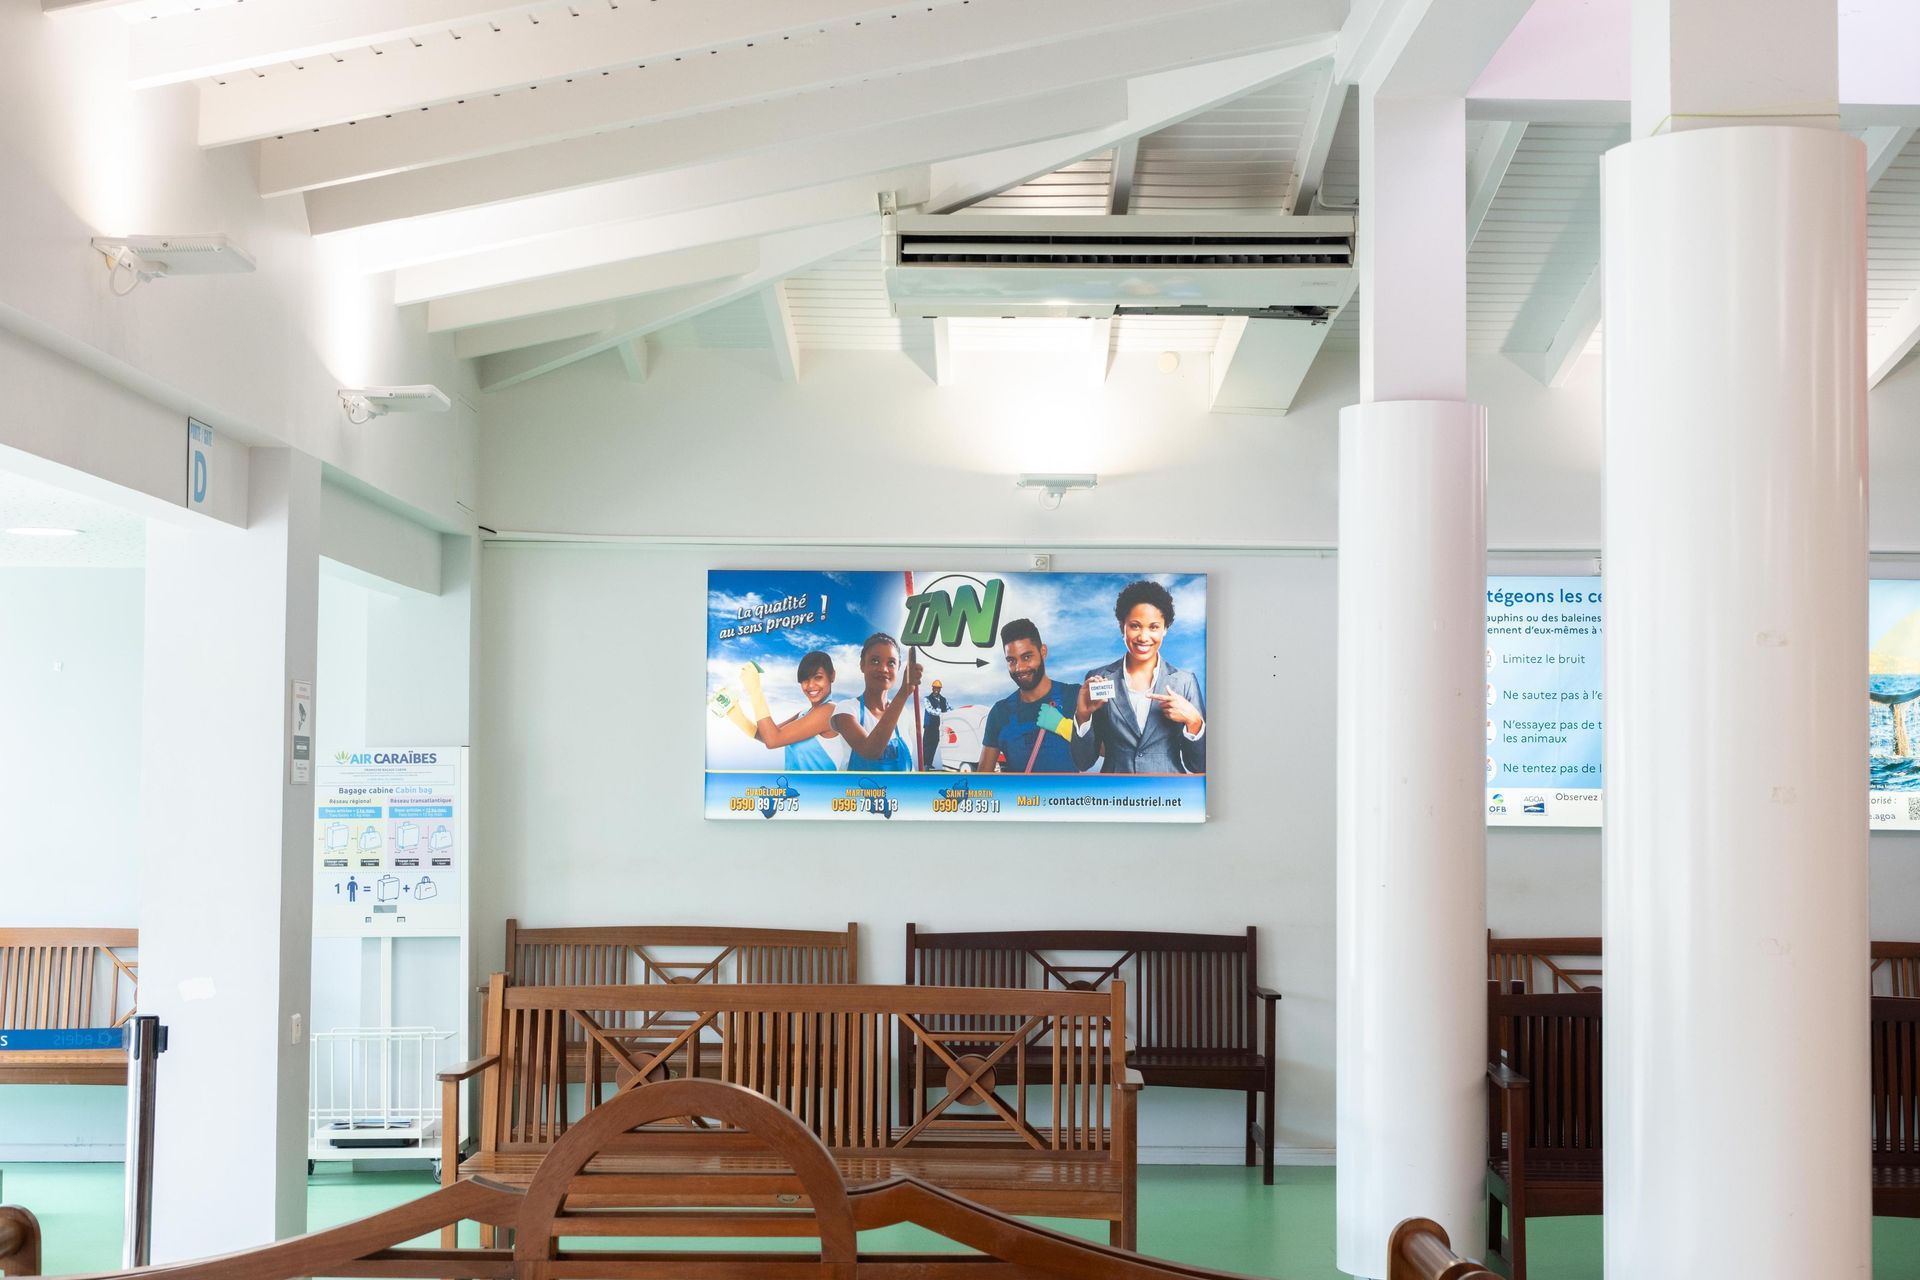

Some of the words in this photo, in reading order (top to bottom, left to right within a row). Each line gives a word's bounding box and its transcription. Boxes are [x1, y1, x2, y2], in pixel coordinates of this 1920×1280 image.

[194, 450, 207, 503] D
[1487, 588, 1554, 607] tégeons
[1560, 588, 1583, 603] les
[737, 607, 752, 620] La
[755, 594, 807, 619] qualité
[900, 578, 1004, 648] TNN
[720, 628, 736, 639] au
[737, 622, 763, 636] sens
[766, 611, 815, 633] propre
[820, 594, 828, 621] !
[1541, 613, 1559, 622] des
[1561, 613, 1602, 622] baleines
[1487, 626, 1521, 634] ennent
[1525, 626, 1589, 635] d'eux-mêmes
[1591, 626, 1597, 635] à
[1503, 653, 1543, 664] Limitez
[1546, 654, 1555, 664] le
[1558, 653, 1586, 664] bruit
[1503, 690, 1519, 700] Ne
[1522, 691, 1557, 700] sautez
[1560, 692, 1580, 702] pas
[1582, 690, 1589, 700] à
[1503, 720, 1557, 732] N'essayez
[1560, 722, 1579, 732] pas
[1581, 720, 1595, 730] de
[1503, 733, 1518, 743] les
[1521, 733, 1567, 743] animaux
[350, 753, 372, 764] AIR
[374, 750, 437, 764] CARAÏBES
[1503, 763, 1519, 773] Ne
[1522, 764, 1557, 773] tentez
[1560, 765, 1579, 775] pas
[1581, 763, 1596, 773] de
[338, 787, 367, 795] Bagage
[369, 786, 394, 794] cabine
[395, 786, 417, 794] Cabin
[419, 786, 433, 795] bag
[745, 788, 787, 797] GUADELOUPE
[845, 788, 886, 798] MARTINIQUE
[946, 789, 993, 798] SAINT-MARTIN
[1555, 792, 1598, 801] Observez
[410, 797, 452, 805] transatlantique
[730, 797, 755, 811] 0590
[757, 797, 770, 811] 89
[772, 797, 785, 811] 75
[786, 797, 799, 811] 75
[832, 797, 857, 811] 0596
[860, 798, 872, 811] 70
[874, 798, 885, 811] 13
[887, 799, 898, 811] 13
[933, 798, 958, 812] 0590
[960, 799, 973, 813] 48
[975, 799, 988, 813] 59
[990, 799, 1000, 813] 11
[1016, 795, 1040, 806] Mail
[1048, 795, 1182, 807] contact@tnn-industriel.net
[1489, 805, 1507, 813] OFB
[334, 883, 340, 894] 1
